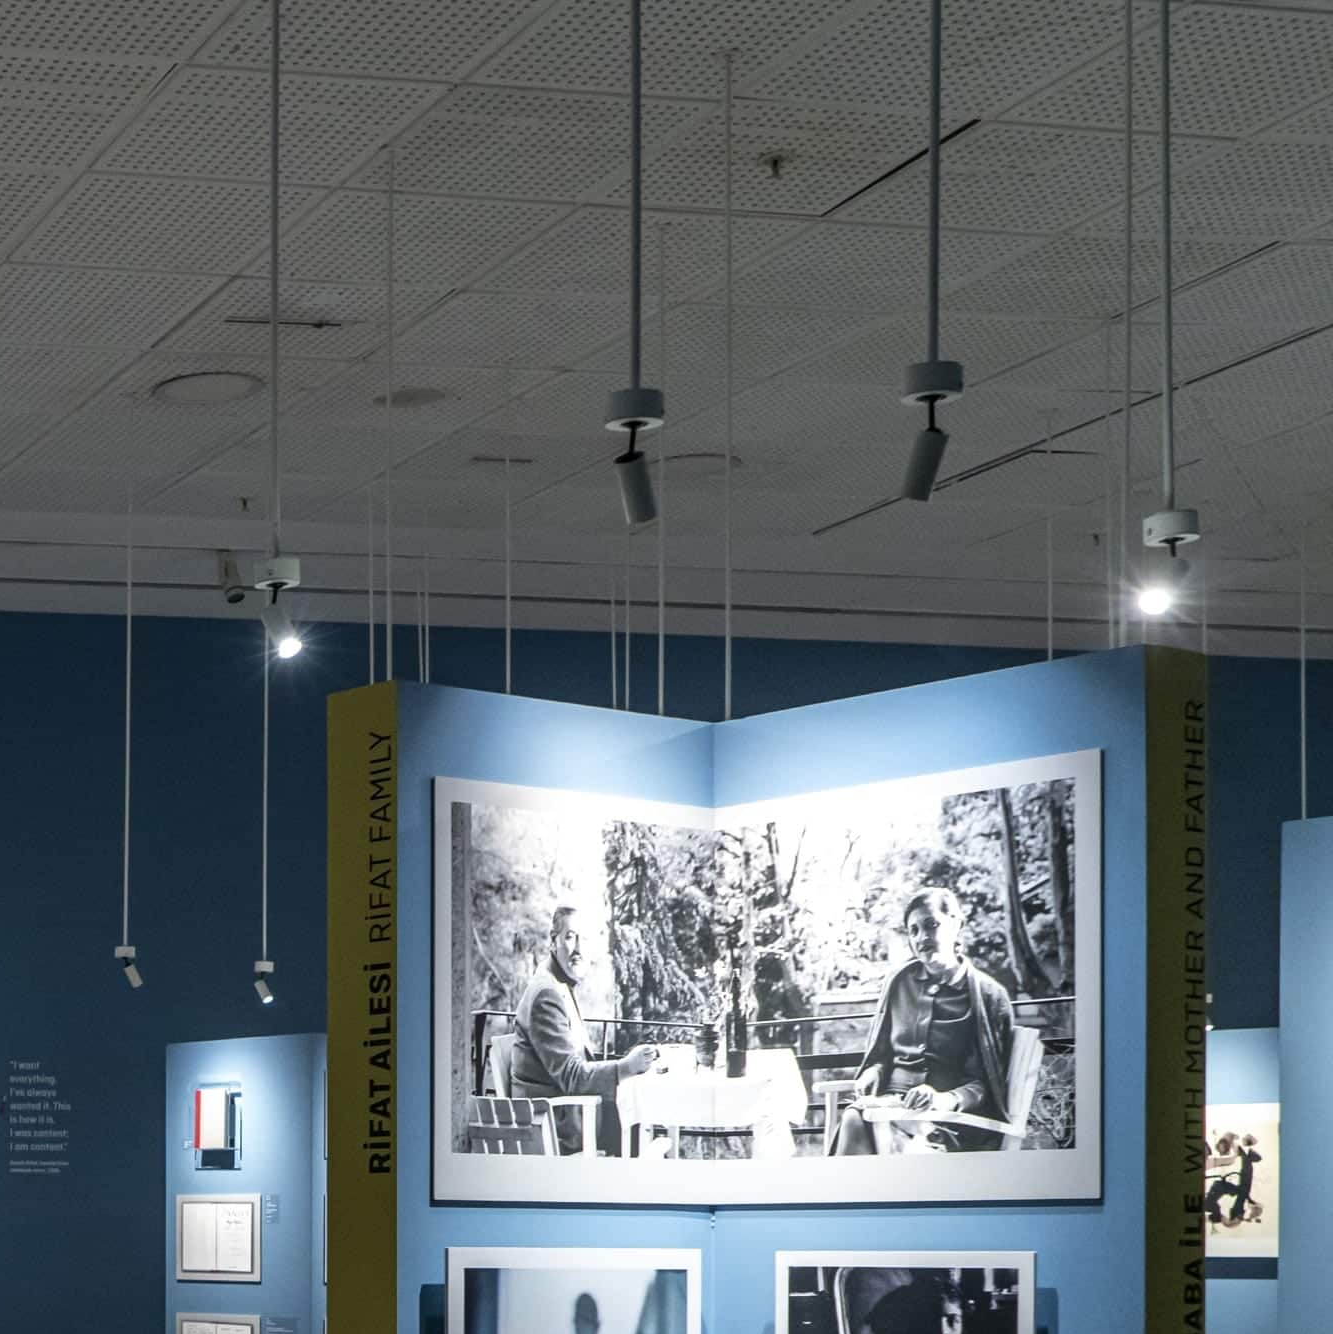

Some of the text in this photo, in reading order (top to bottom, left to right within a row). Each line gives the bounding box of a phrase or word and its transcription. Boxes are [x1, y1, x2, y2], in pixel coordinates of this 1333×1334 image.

[1183, 699, 1206, 832] FATHER
[1183, 846, 1205, 919] AND
[363, 731, 392, 1174] RİFAT AİLESİ RİFAT FAMILY
[1183, 930, 1205, 1072] MOTHER
[18, 1060, 40, 1070] want
[9, 1102, 42, 1111] wanted
[53, 1102, 72, 1111] This
[26, 1088, 57, 1098] always
[9, 1115, 18, 1124] is
[19, 1115, 37, 1124] how
[14, 1129, 32, 1137] was
[1183, 1087, 1204, 1173] WITH
[14, 1143, 29, 1151] am
[1179, 1194, 1204, 1247] İLE
